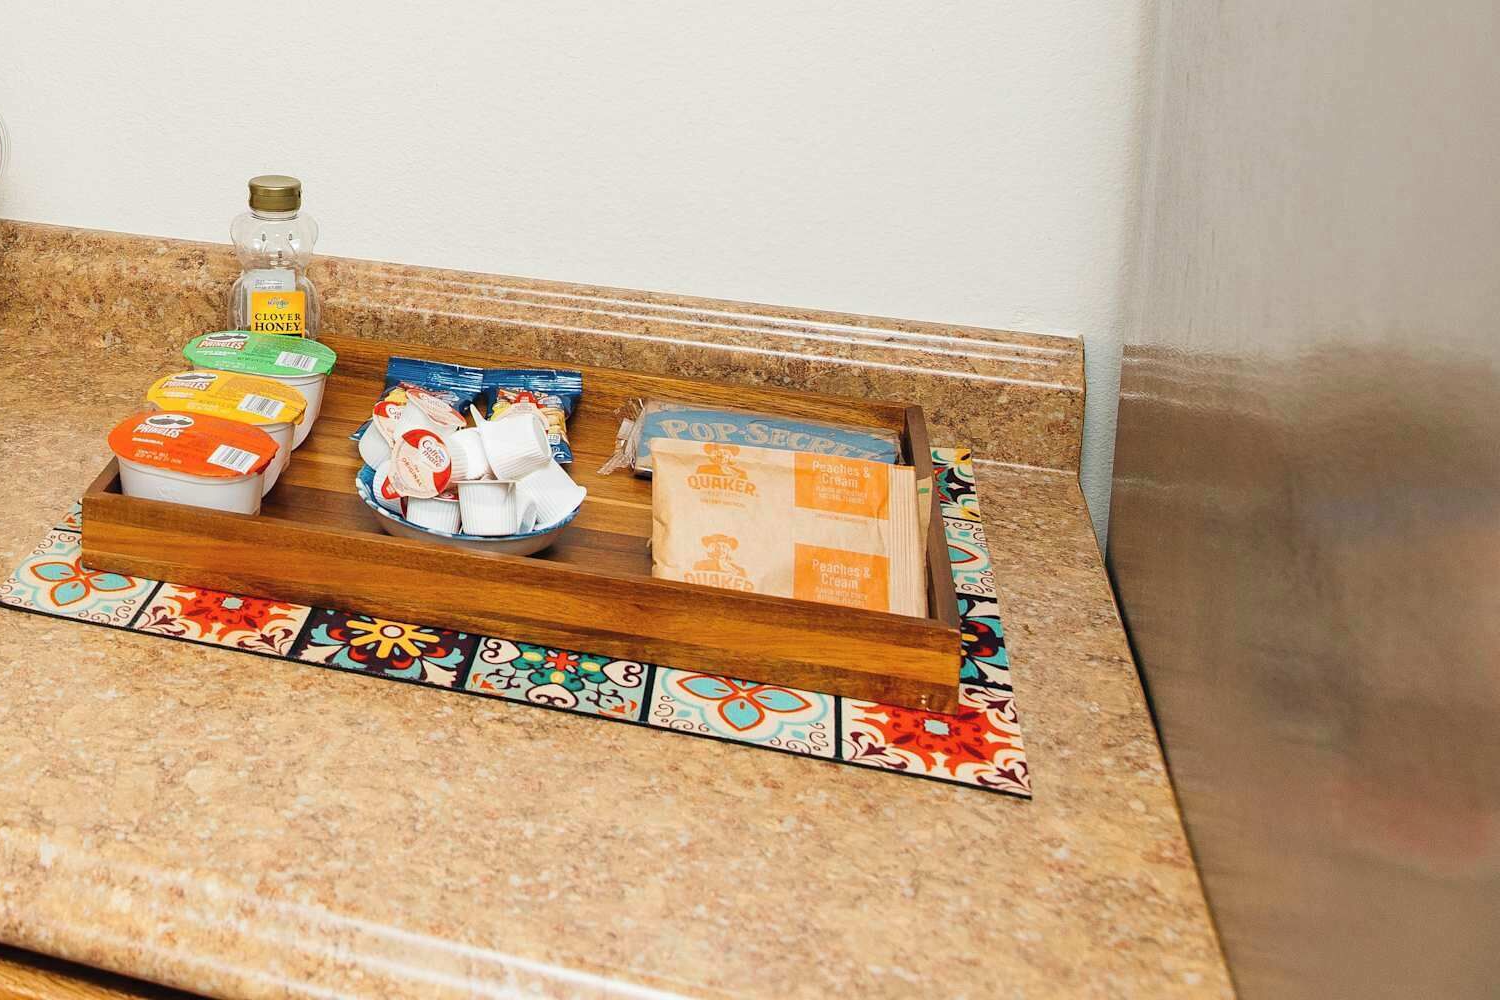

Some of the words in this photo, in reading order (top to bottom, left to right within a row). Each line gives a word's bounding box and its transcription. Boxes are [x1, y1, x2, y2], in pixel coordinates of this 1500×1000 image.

[254, 312, 301, 321] CLOVER
[255, 322, 300, 331] HONEY
[813, 460, 859, 476] Peaches
[687, 475, 756, 496] QUAKER
[822, 472, 858, 488] Cream
[812, 559, 860, 577] Peaches
[822, 573, 858, 589] Cream
